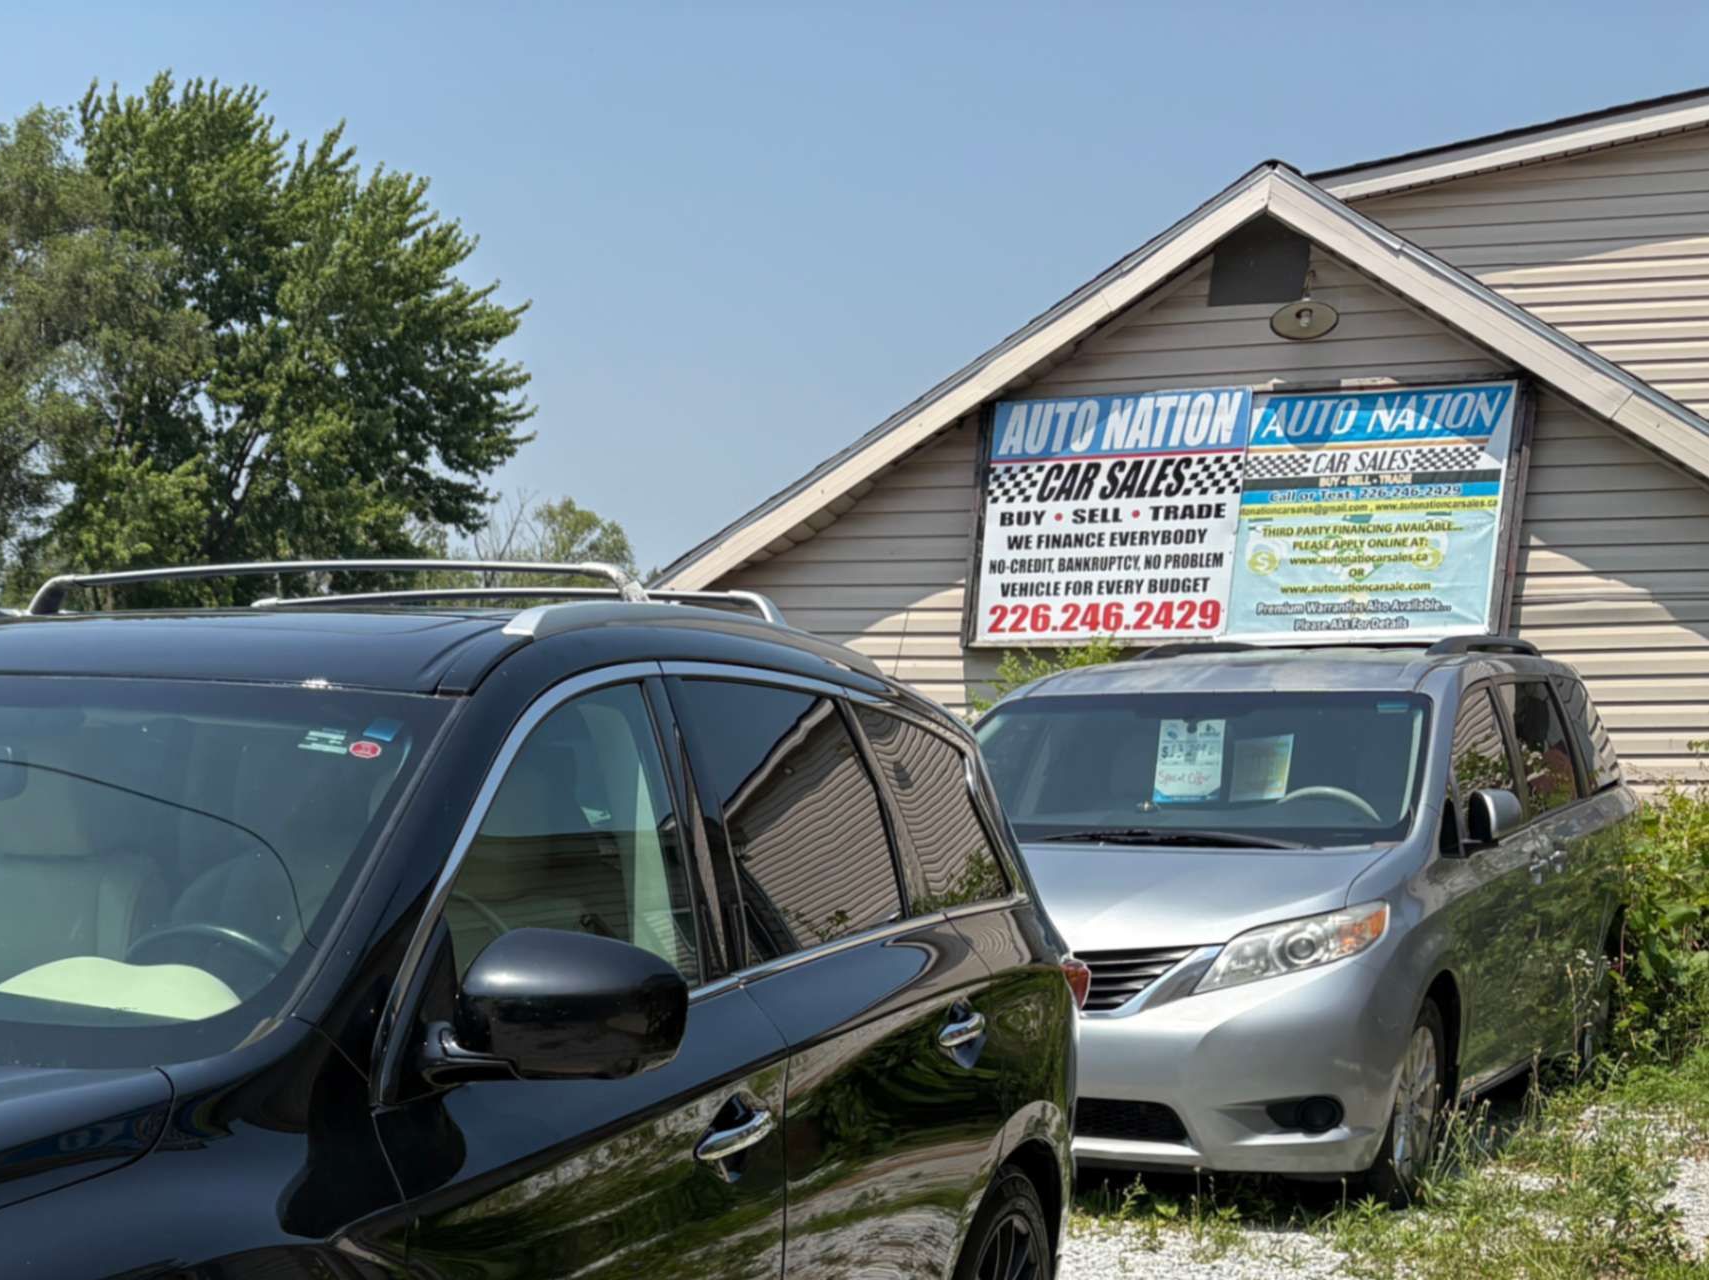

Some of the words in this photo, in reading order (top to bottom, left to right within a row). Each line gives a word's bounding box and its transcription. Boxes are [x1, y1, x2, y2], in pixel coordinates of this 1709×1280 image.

[998, 399, 1100, 455] AUTO
[1100, 391, 1243, 450] NATION
[1261, 398, 1360, 438] AUTO
[1366, 391, 1502, 433] NATION
[1312, 452, 1351, 474] CAR
[1354, 449, 1412, 473] SALES
[1036, 462, 1102, 502] CAR
[1098, 456, 1193, 500] SALES
[1269, 490, 1296, 503] Call
[1298, 490, 1316, 502] or
[1361, 484, 1461, 499] 226-246-2429
[999, 510, 1046, 527] BUY
[1072, 507, 1123, 524] SELL
[1149, 502, 1227, 521] TRADE
[1007, 534, 1033, 550] WE
[1036, 532, 1105, 549] FINANCE
[1109, 528, 1208, 547] EVERYBODY
[1262, 527, 1294, 538] THIRD
[1296, 525, 1332, 536] PARTY
[1332, 523, 1392, 535] FINANCING
[1292, 540, 1331, 551] PLEASE
[1332, 539, 1365, 550] APPLY
[1367, 537, 1409, 548] ONLINE
[1143, 553, 1162, 570] NO
[1164, 552, 1224, 569] PROBLEM
[1348, 567, 1365, 578] OR
[1000, 581, 1061, 597] VEHICLE
[1064, 580, 1093, 596] FOR
[1097, 578, 1144, 595] EVERY
[1147, 577, 1210, 594] BUDGET
[987, 599, 1221, 633] 226.246.2429
[1256, 601, 1304, 615] Premium
[1305, 600, 1365, 614] Warranties
[1366, 599, 1391, 613] Also
[1294, 619, 1329, 631] Please
[1351, 617, 1369, 630] For
[1370, 616, 1409, 629] Details
